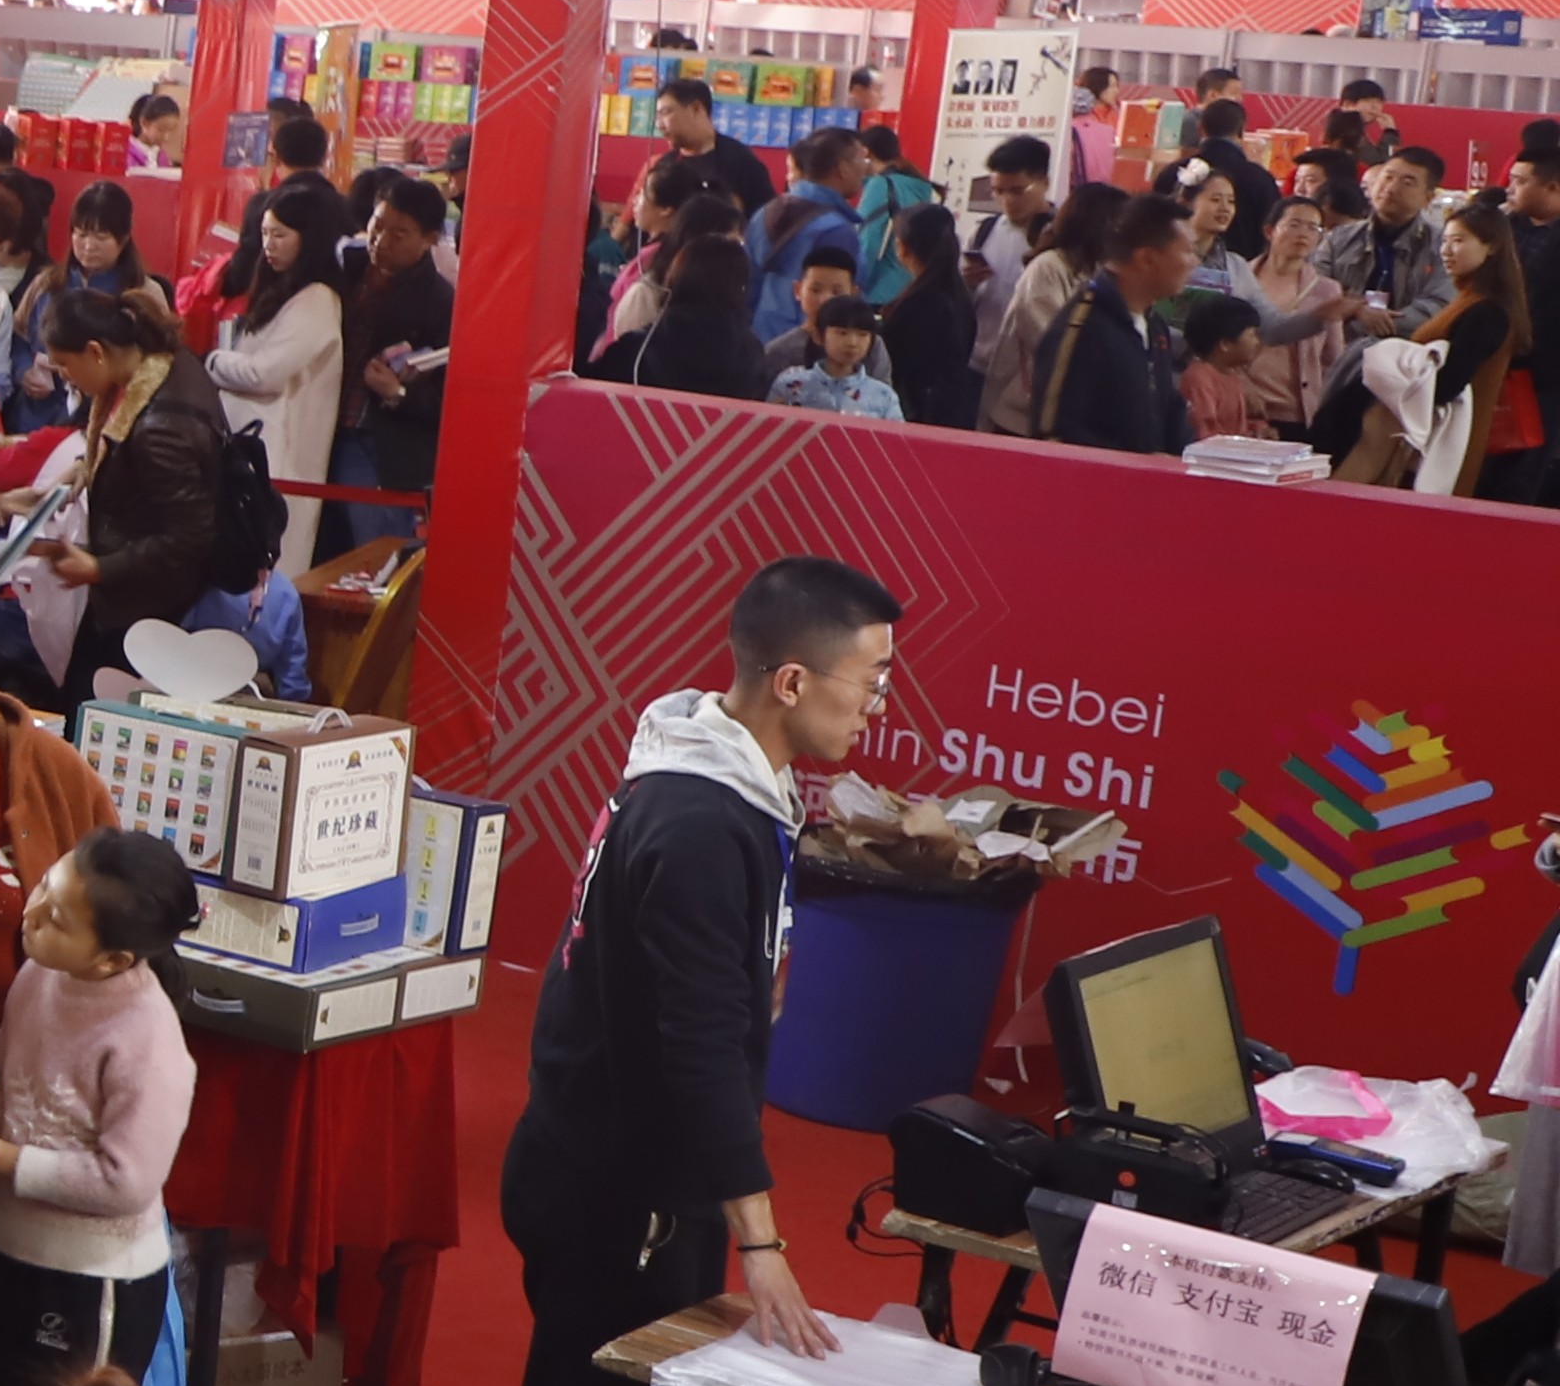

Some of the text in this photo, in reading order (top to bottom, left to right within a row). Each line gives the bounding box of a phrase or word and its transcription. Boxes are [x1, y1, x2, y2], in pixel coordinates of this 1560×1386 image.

[985, 664, 1165, 739] Hebei
[939, 728, 1046, 790] Shu
[1063, 751, 1155, 810] Shi
[316, 809, 379, 841] 世纪珍藏
[1097, 1260, 1338, 1348] 微信 支付宝 现金
